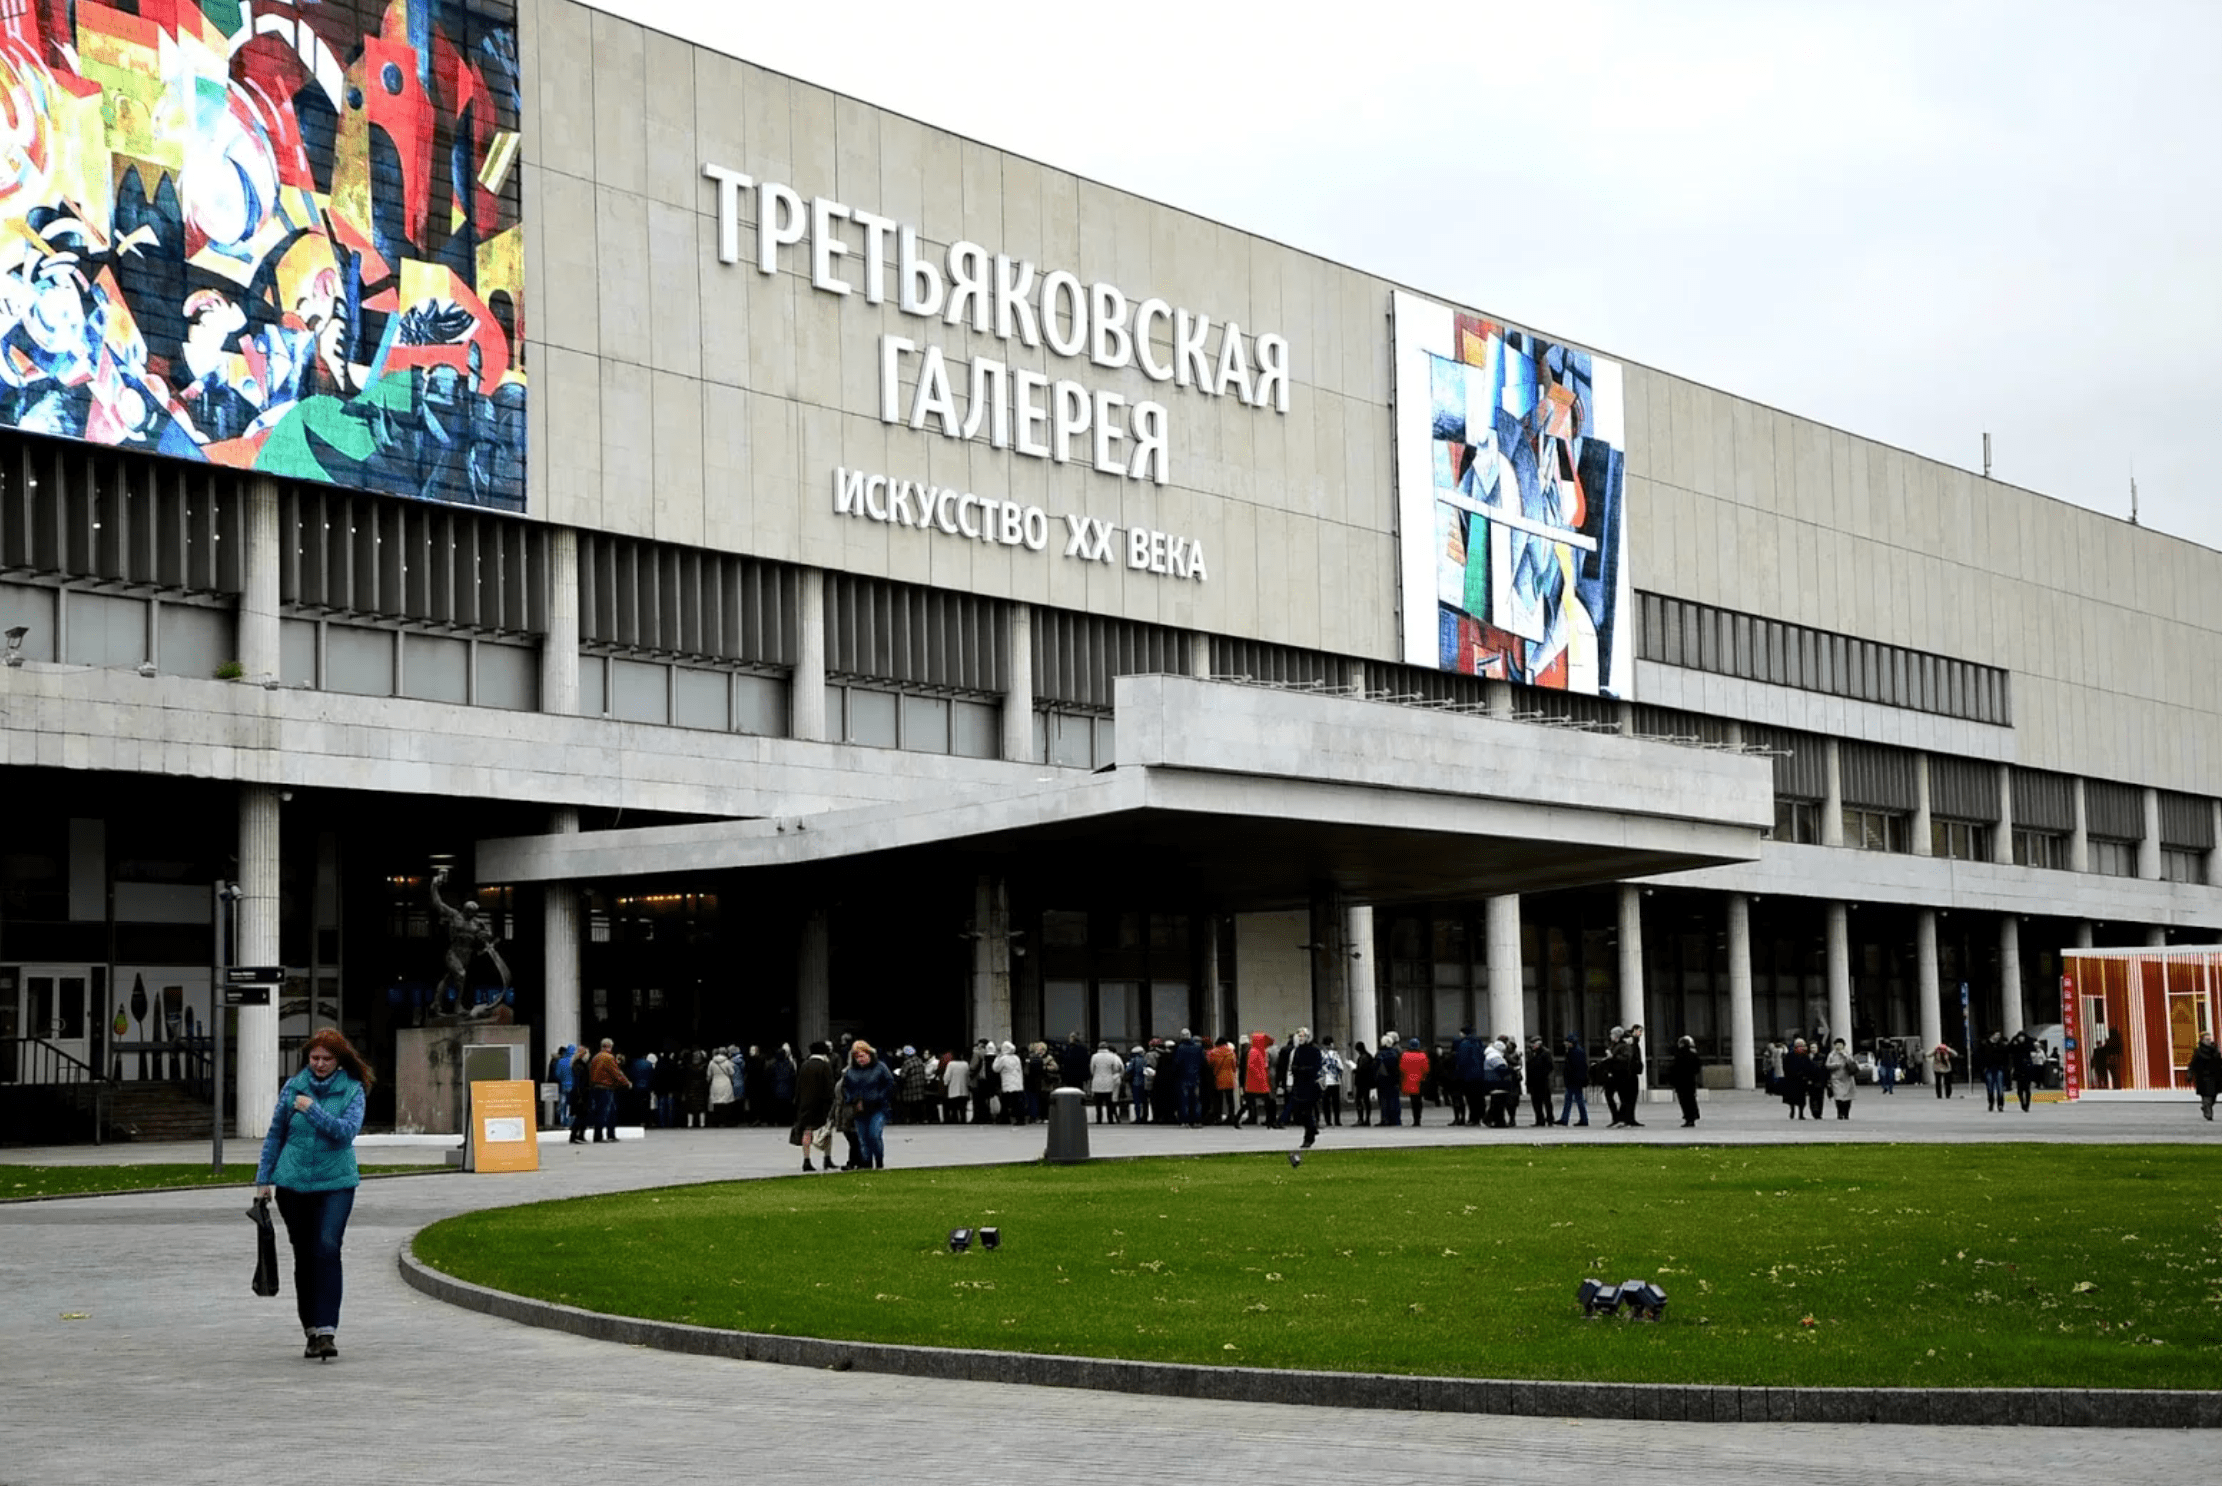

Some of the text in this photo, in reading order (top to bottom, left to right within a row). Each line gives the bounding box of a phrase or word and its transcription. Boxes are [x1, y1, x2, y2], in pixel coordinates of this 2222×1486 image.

[703, 163, 1290, 413] ТРЕТЬЯКОВСКАЯ
[880, 335, 1170, 485] ГАЛЕРЕЯ
[833, 467, 1049, 551] ИСКУССТВО
[1127, 527, 1208, 580] ВЕКА
